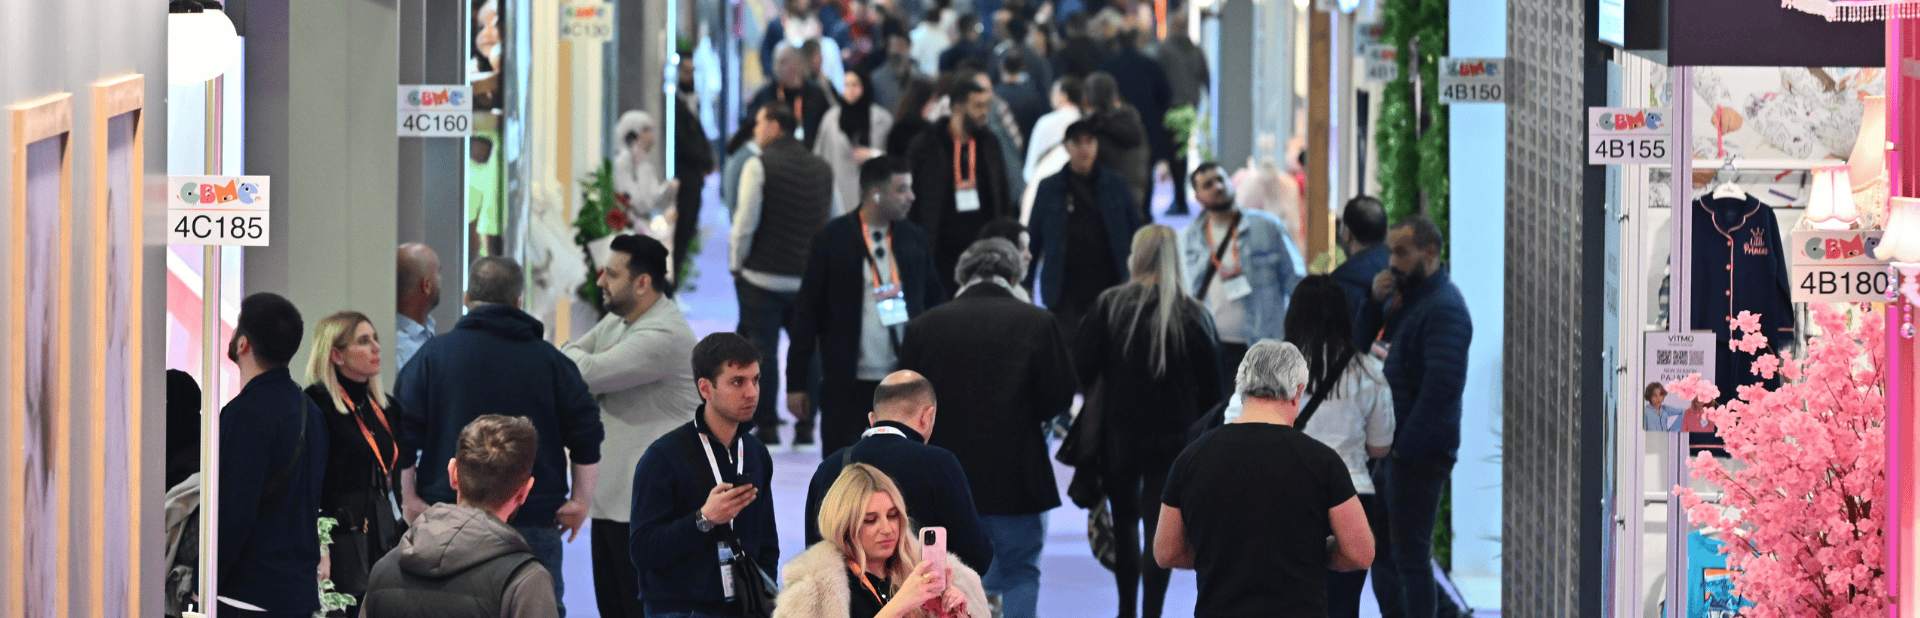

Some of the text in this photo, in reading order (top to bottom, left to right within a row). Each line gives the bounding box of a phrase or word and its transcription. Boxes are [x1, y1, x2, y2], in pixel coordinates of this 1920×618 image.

[1444, 84, 1501, 100] 4B150
[403, 114, 468, 131] 4C160
[1595, 140, 1665, 158] 4B155
[174, 215, 263, 239] 4C185
[1800, 271, 1889, 295] 4B180
